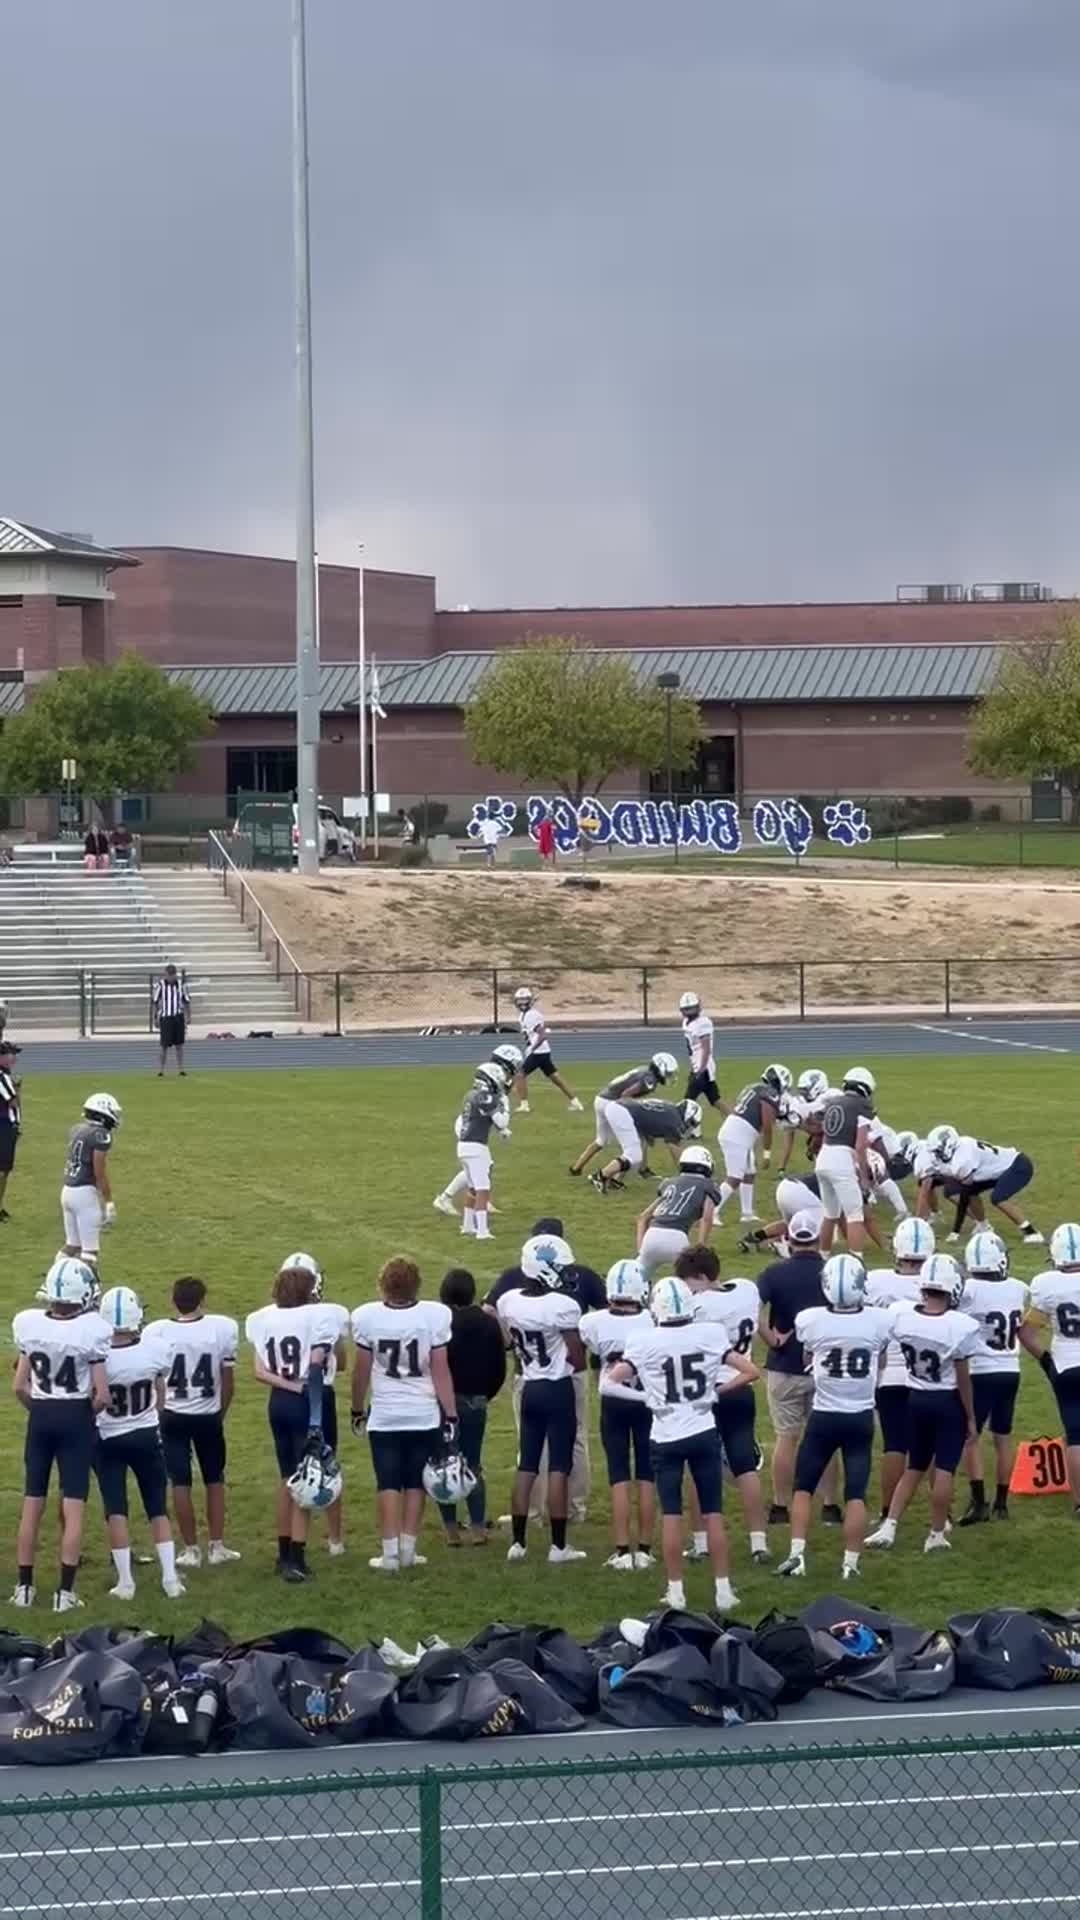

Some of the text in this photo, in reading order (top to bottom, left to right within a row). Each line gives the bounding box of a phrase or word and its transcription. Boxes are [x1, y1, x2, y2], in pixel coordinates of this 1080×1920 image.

[653, 1184, 697, 1216] 21
[167, 1353, 215, 1398] 44
[265, 1336, 301, 1380] 19
[378, 1338, 423, 1379] 71
[662, 1353, 707, 1403] 15
[821, 1348, 870, 1379] 40
[1028, 1442, 1066, 1488] 30
